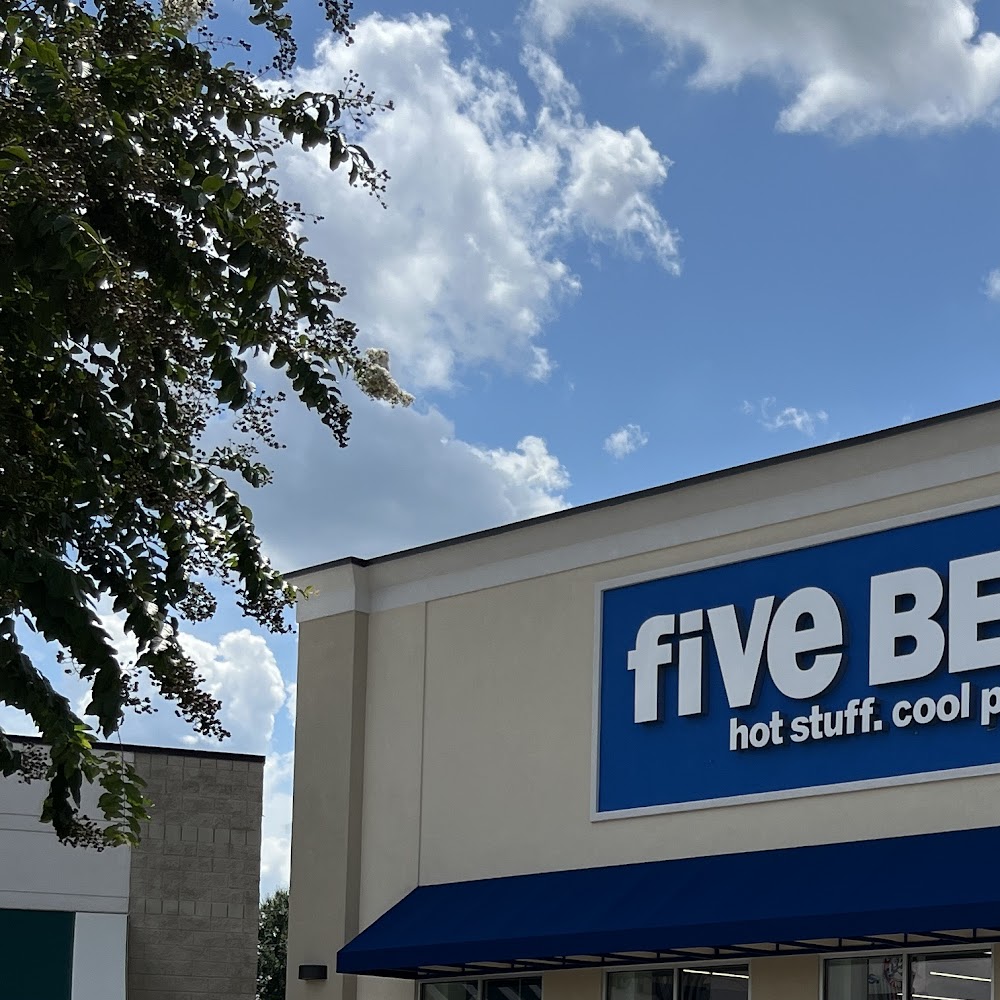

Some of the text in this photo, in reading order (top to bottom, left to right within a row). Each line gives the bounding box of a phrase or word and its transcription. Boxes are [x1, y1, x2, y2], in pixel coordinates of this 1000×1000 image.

[628, 587, 843, 724] five
[729, 710, 783, 751] hot
[790, 698, 882, 743] stuff.
[892, 682, 970, 728] cool
